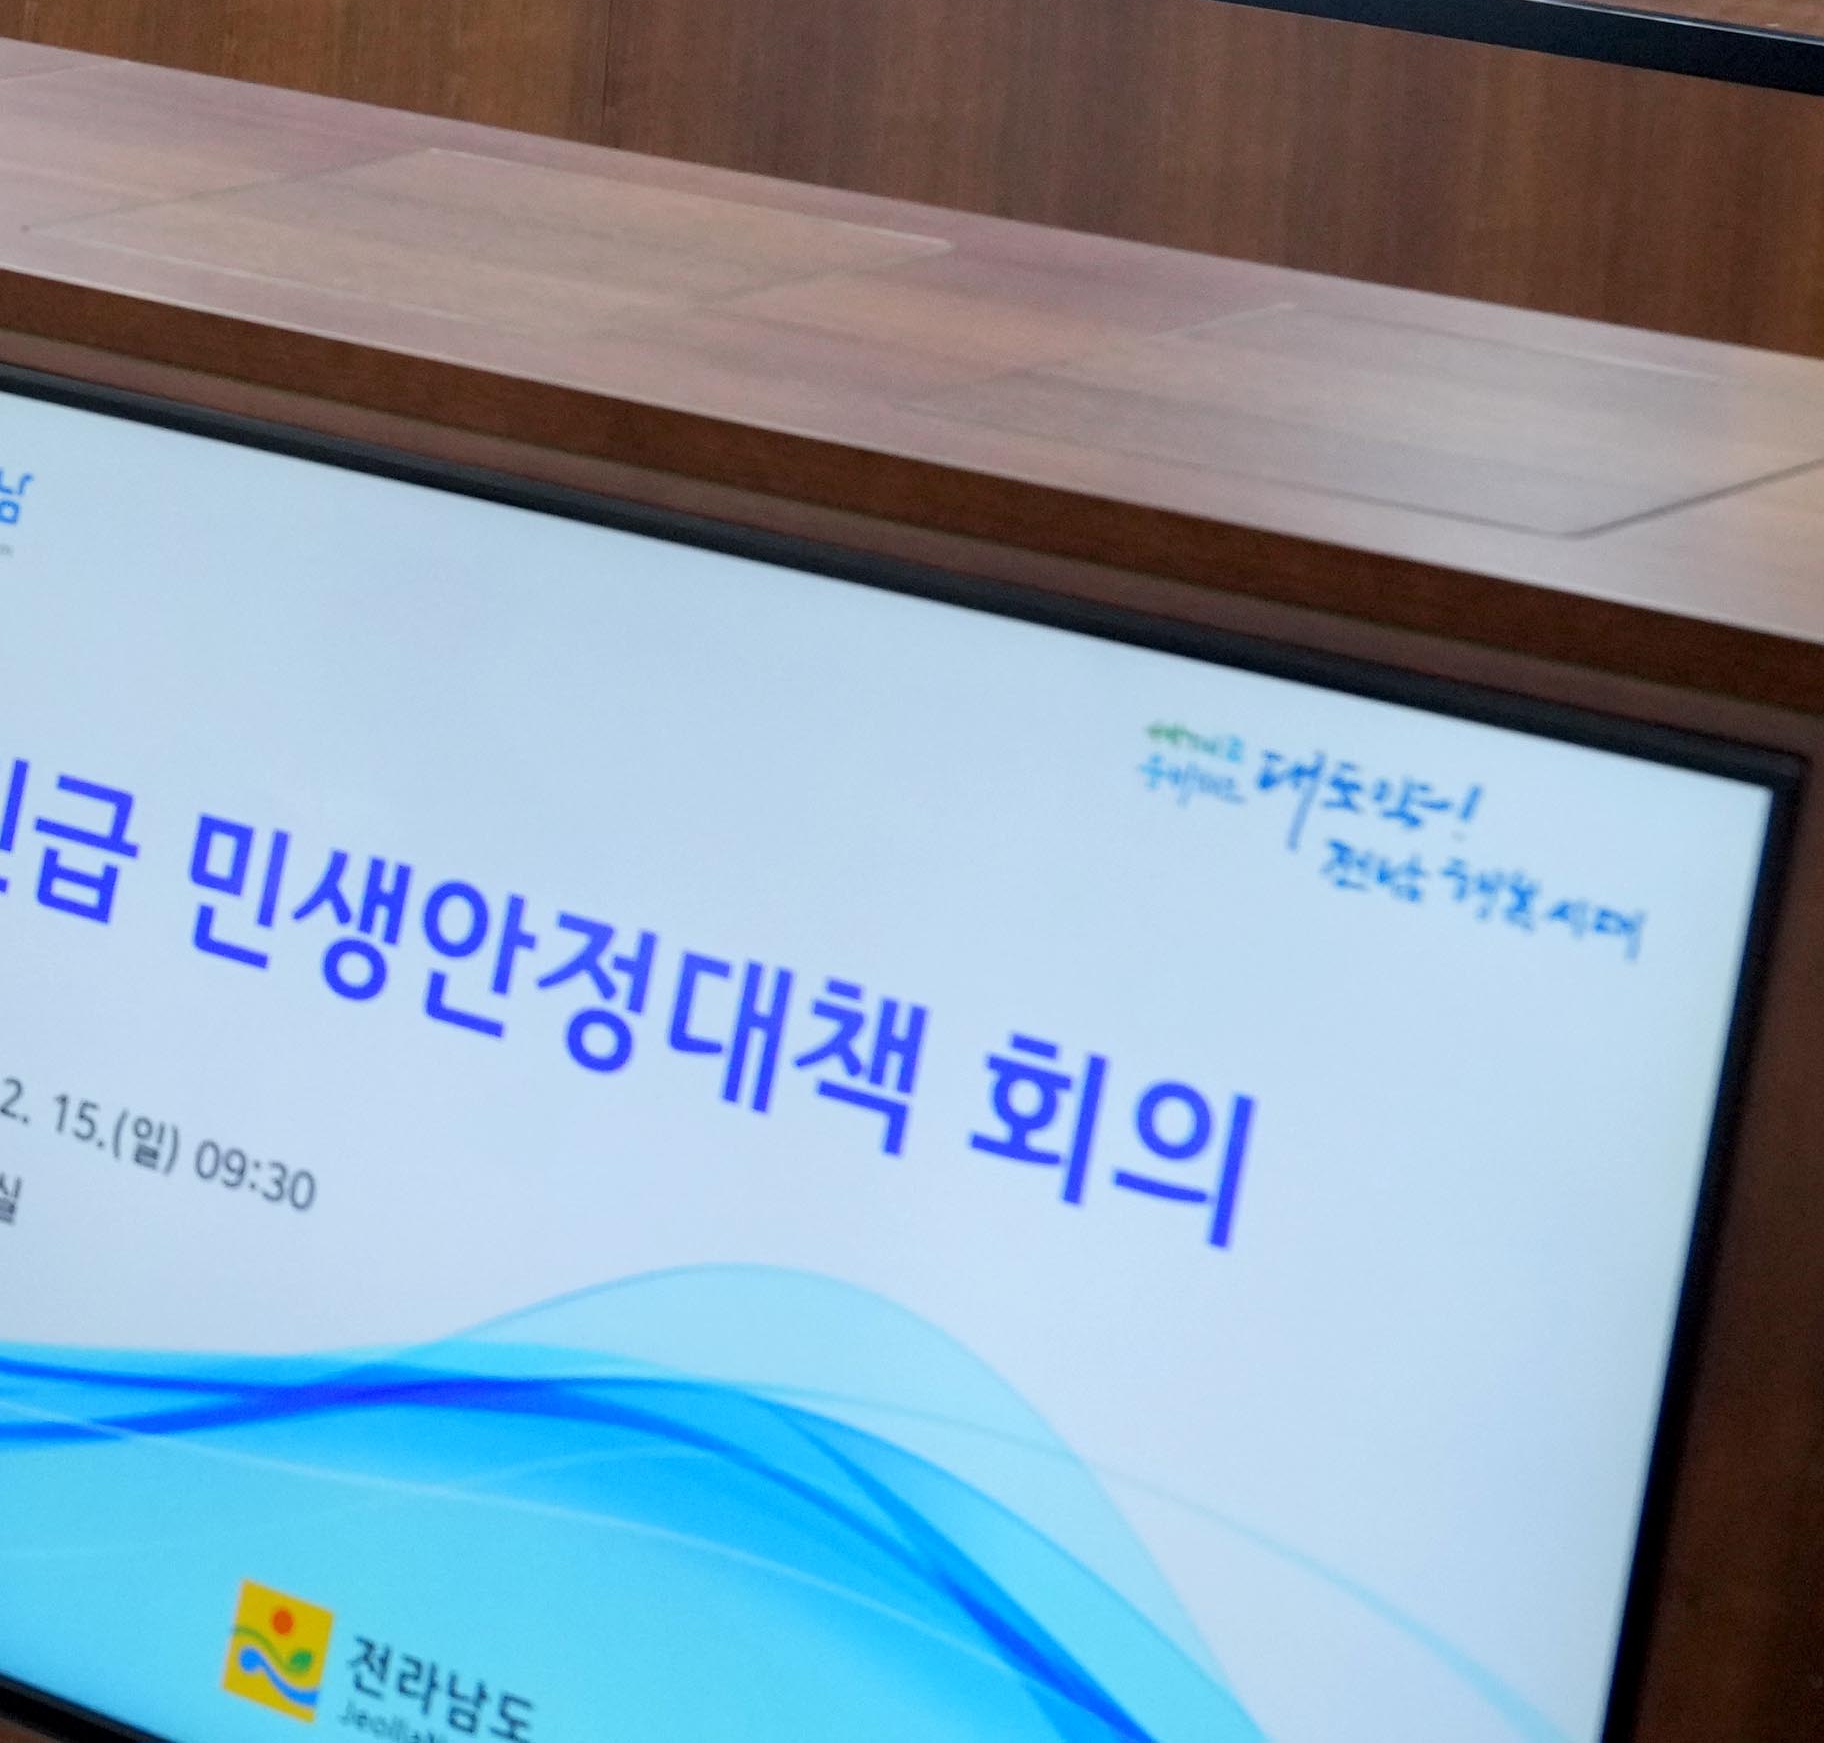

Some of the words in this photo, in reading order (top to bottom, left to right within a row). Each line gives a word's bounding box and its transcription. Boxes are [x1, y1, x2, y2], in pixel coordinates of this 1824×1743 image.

[187, 812, 930, 1157] 민생안정대책
[970, 1032, 1258, 1250] 회의
[194, 1141, 317, 1212] 09:30
[346, 1633, 538, 1743] 전라남도
